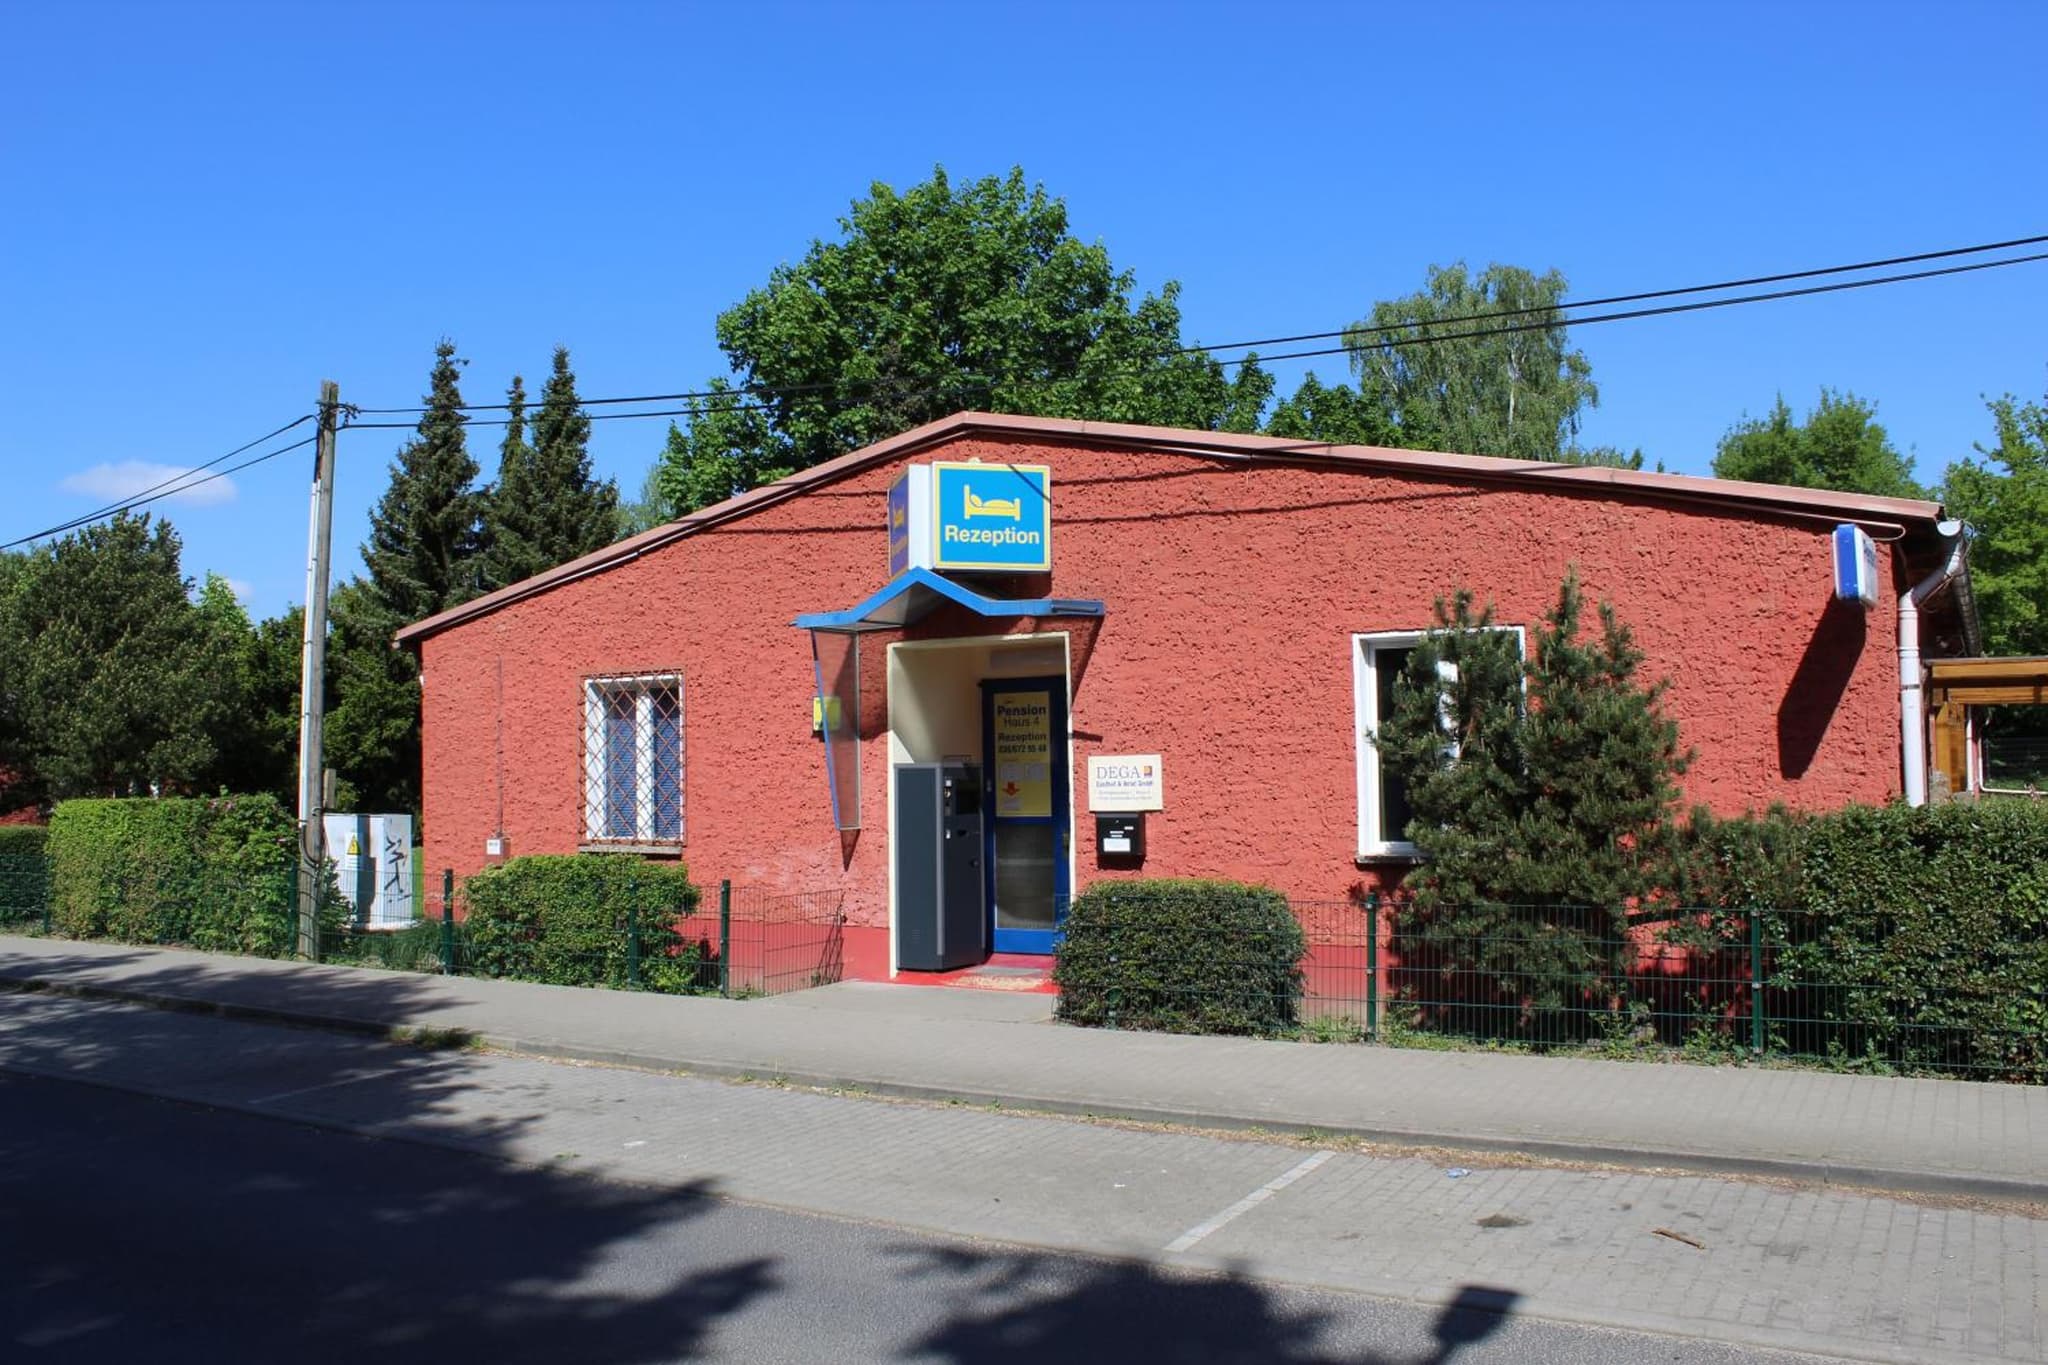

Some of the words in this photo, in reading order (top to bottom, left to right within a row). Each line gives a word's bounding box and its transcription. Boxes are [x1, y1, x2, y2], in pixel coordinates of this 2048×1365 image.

[944, 524, 1040, 547] Rezeption
[997, 704, 1046, 715] Pension
[1096, 765, 1141, 779] DEGA
